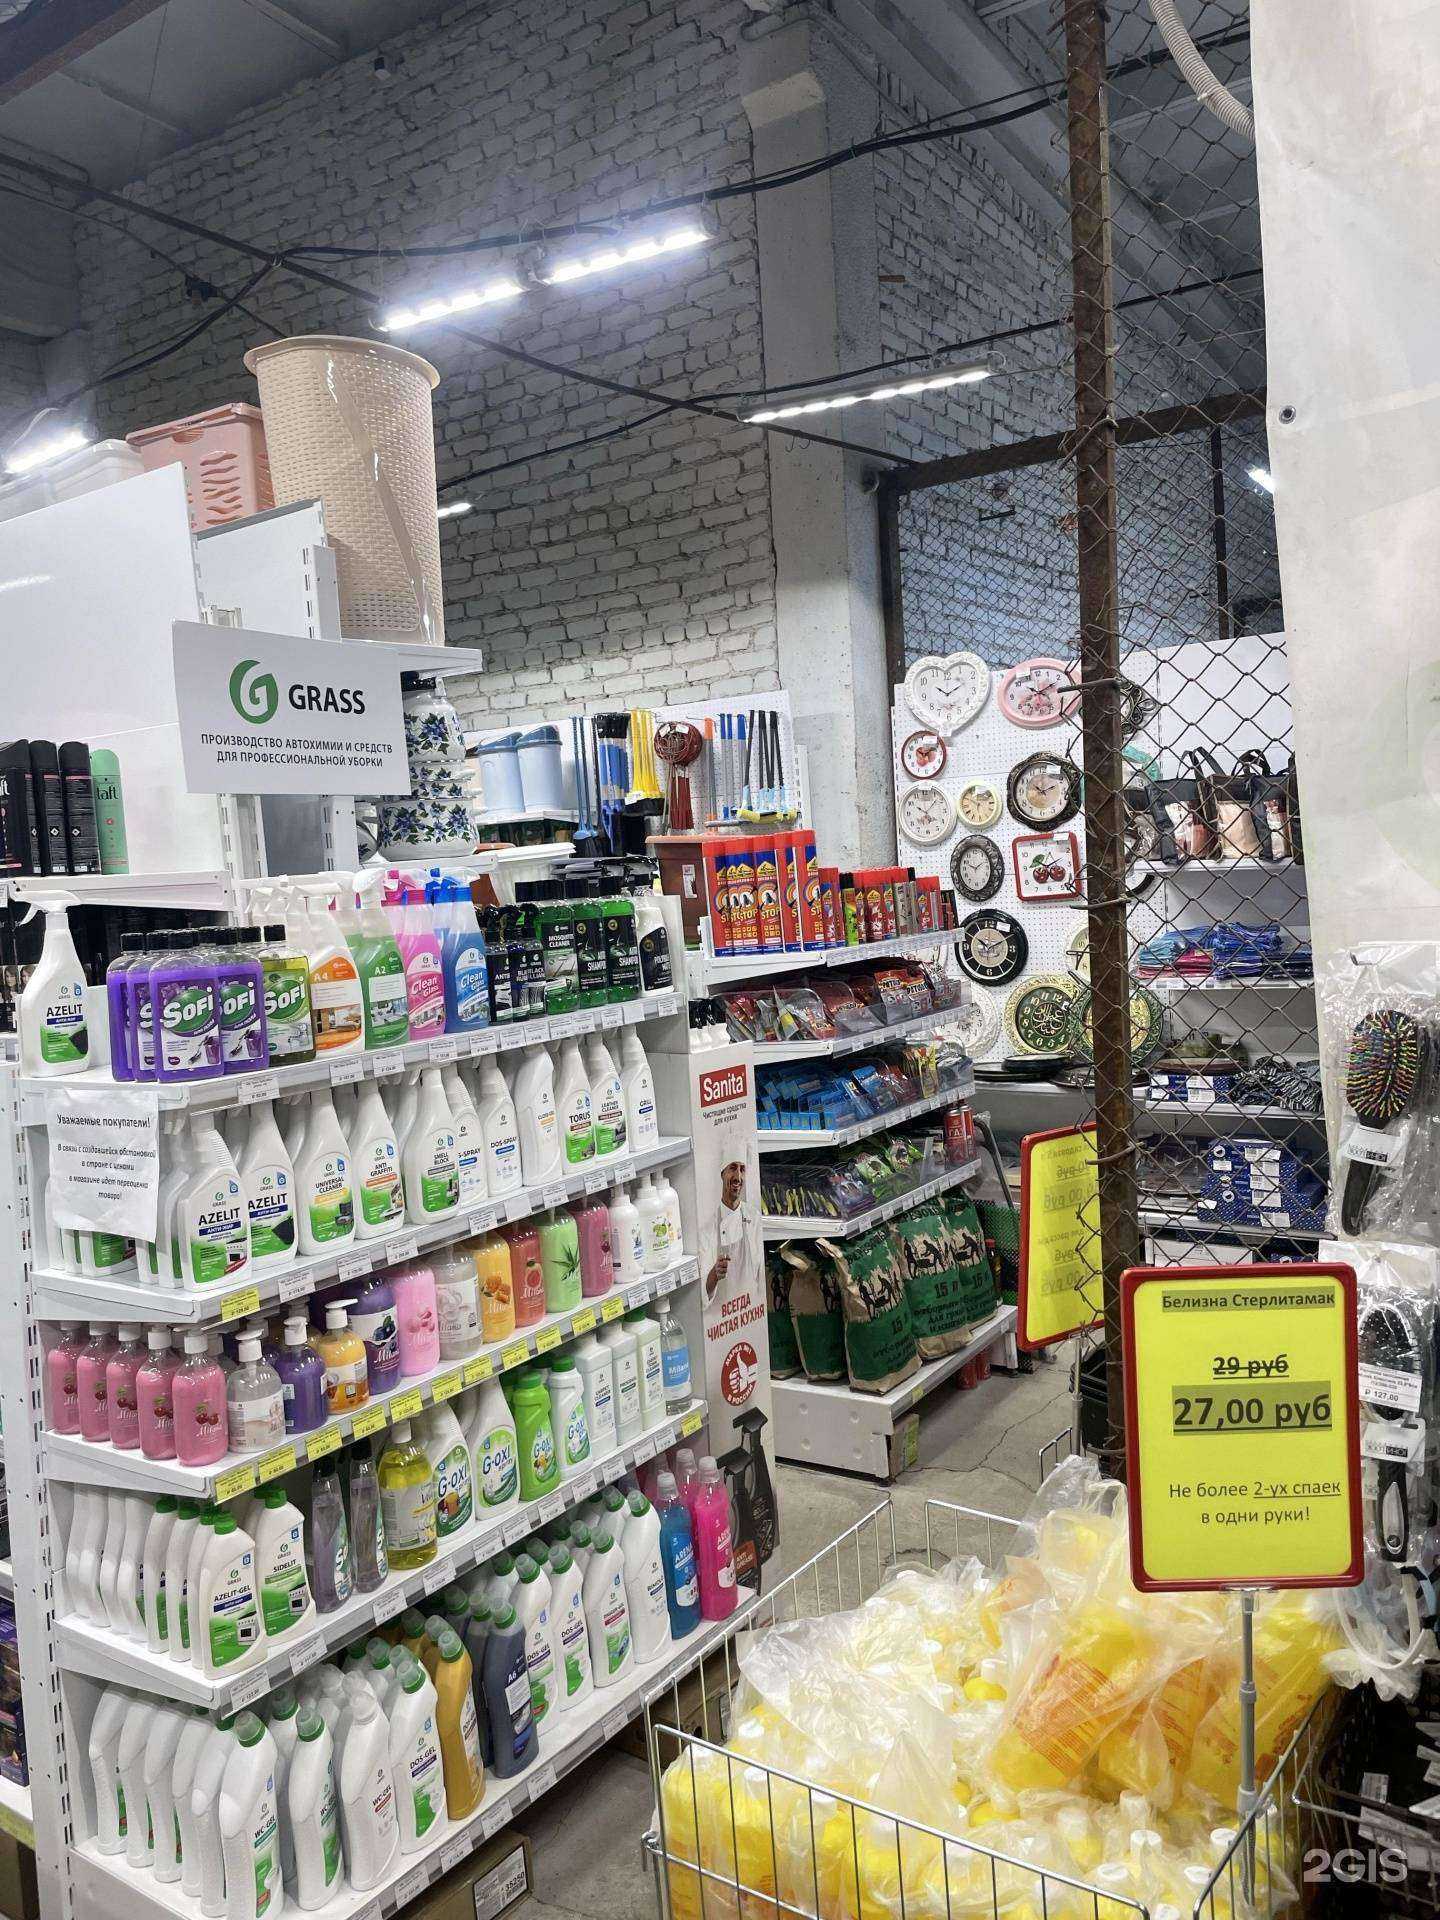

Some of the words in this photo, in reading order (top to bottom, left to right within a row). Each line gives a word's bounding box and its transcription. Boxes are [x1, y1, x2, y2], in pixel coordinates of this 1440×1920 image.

[288, 684, 365, 714] GRASS
[201, 733, 283, 748] ПРОИЗВОДСТВО
[285, 739, 343, 751] АВТОХИМИИ
[345, 742, 351, 751] И
[354, 743, 393, 754] СРЕДСТВ
[217, 751, 237, 763] ДЛЯ
[240, 752, 346, 766] ПРОФЕССИОНАЛЬНОЙ
[348, 757, 383, 767] УБОРКИ
[984, 920, 994, 928] 12
[314, 972, 329, 982] A4
[374, 967, 387, 975] A2
[411, 976, 438, 995] Clean
[460, 972, 483, 989] Clean
[46, 1004, 82, 1017] AZELIT
[703, 1073, 744, 1102] Sanita
[56, 1114, 101, 1126] Уважаемые
[102, 1117, 151, 1129] покупатели!
[569, 1111, 591, 1124] TORUS
[370, 1167, 393, 1177] GRAFFITI
[315, 1177, 345, 1189] UNIVERSAL
[319, 1183, 343, 1194] CLEANER
[248, 1193, 288, 1211] AZELIT
[198, 1208, 240, 1226] AZELIT
[721, 1293, 751, 1318] ВСЕГДА
[1163, 1295, 1228, 1308] Белизна
[1232, 1293, 1335, 1309] Стерлитамак
[707, 1317, 740, 1342] ЧИСТАЯ
[740, 1304, 765, 1327] КУХНЯ
[1213, 1357, 1240, 1375] 29
[1248, 1354, 1289, 1378] руб
[1174, 1397, 1264, 1430] 27,00
[1275, 1394, 1331, 1429] руб
[482, 1445, 511, 1475] G-OXI
[437, 1464, 468, 1498] G-OXI
[1169, 1484, 1191, 1498] Не
[1197, 1483, 1248, 1497] более
[1254, 1481, 1287, 1498] 2-ух
[1293, 1481, 1341, 1495] спаек
[1201, 1513, 1210, 1524] в
[1215, 1511, 1258, 1526] одни
[1264, 1506, 1310, 1525] руки!
[273, 1559, 297, 1573] SIDELIT
[214, 1585, 251, 1602] AZELIT-GEL
[561, 1620, 583, 1638] DOS-GEL
[526, 1643, 550, 1661] DOS-GEL
[507, 1671, 517, 1683] A6
[409, 1746, 436, 1770] DOS-GEL
[254, 1814, 276, 1839] WC-GEL
